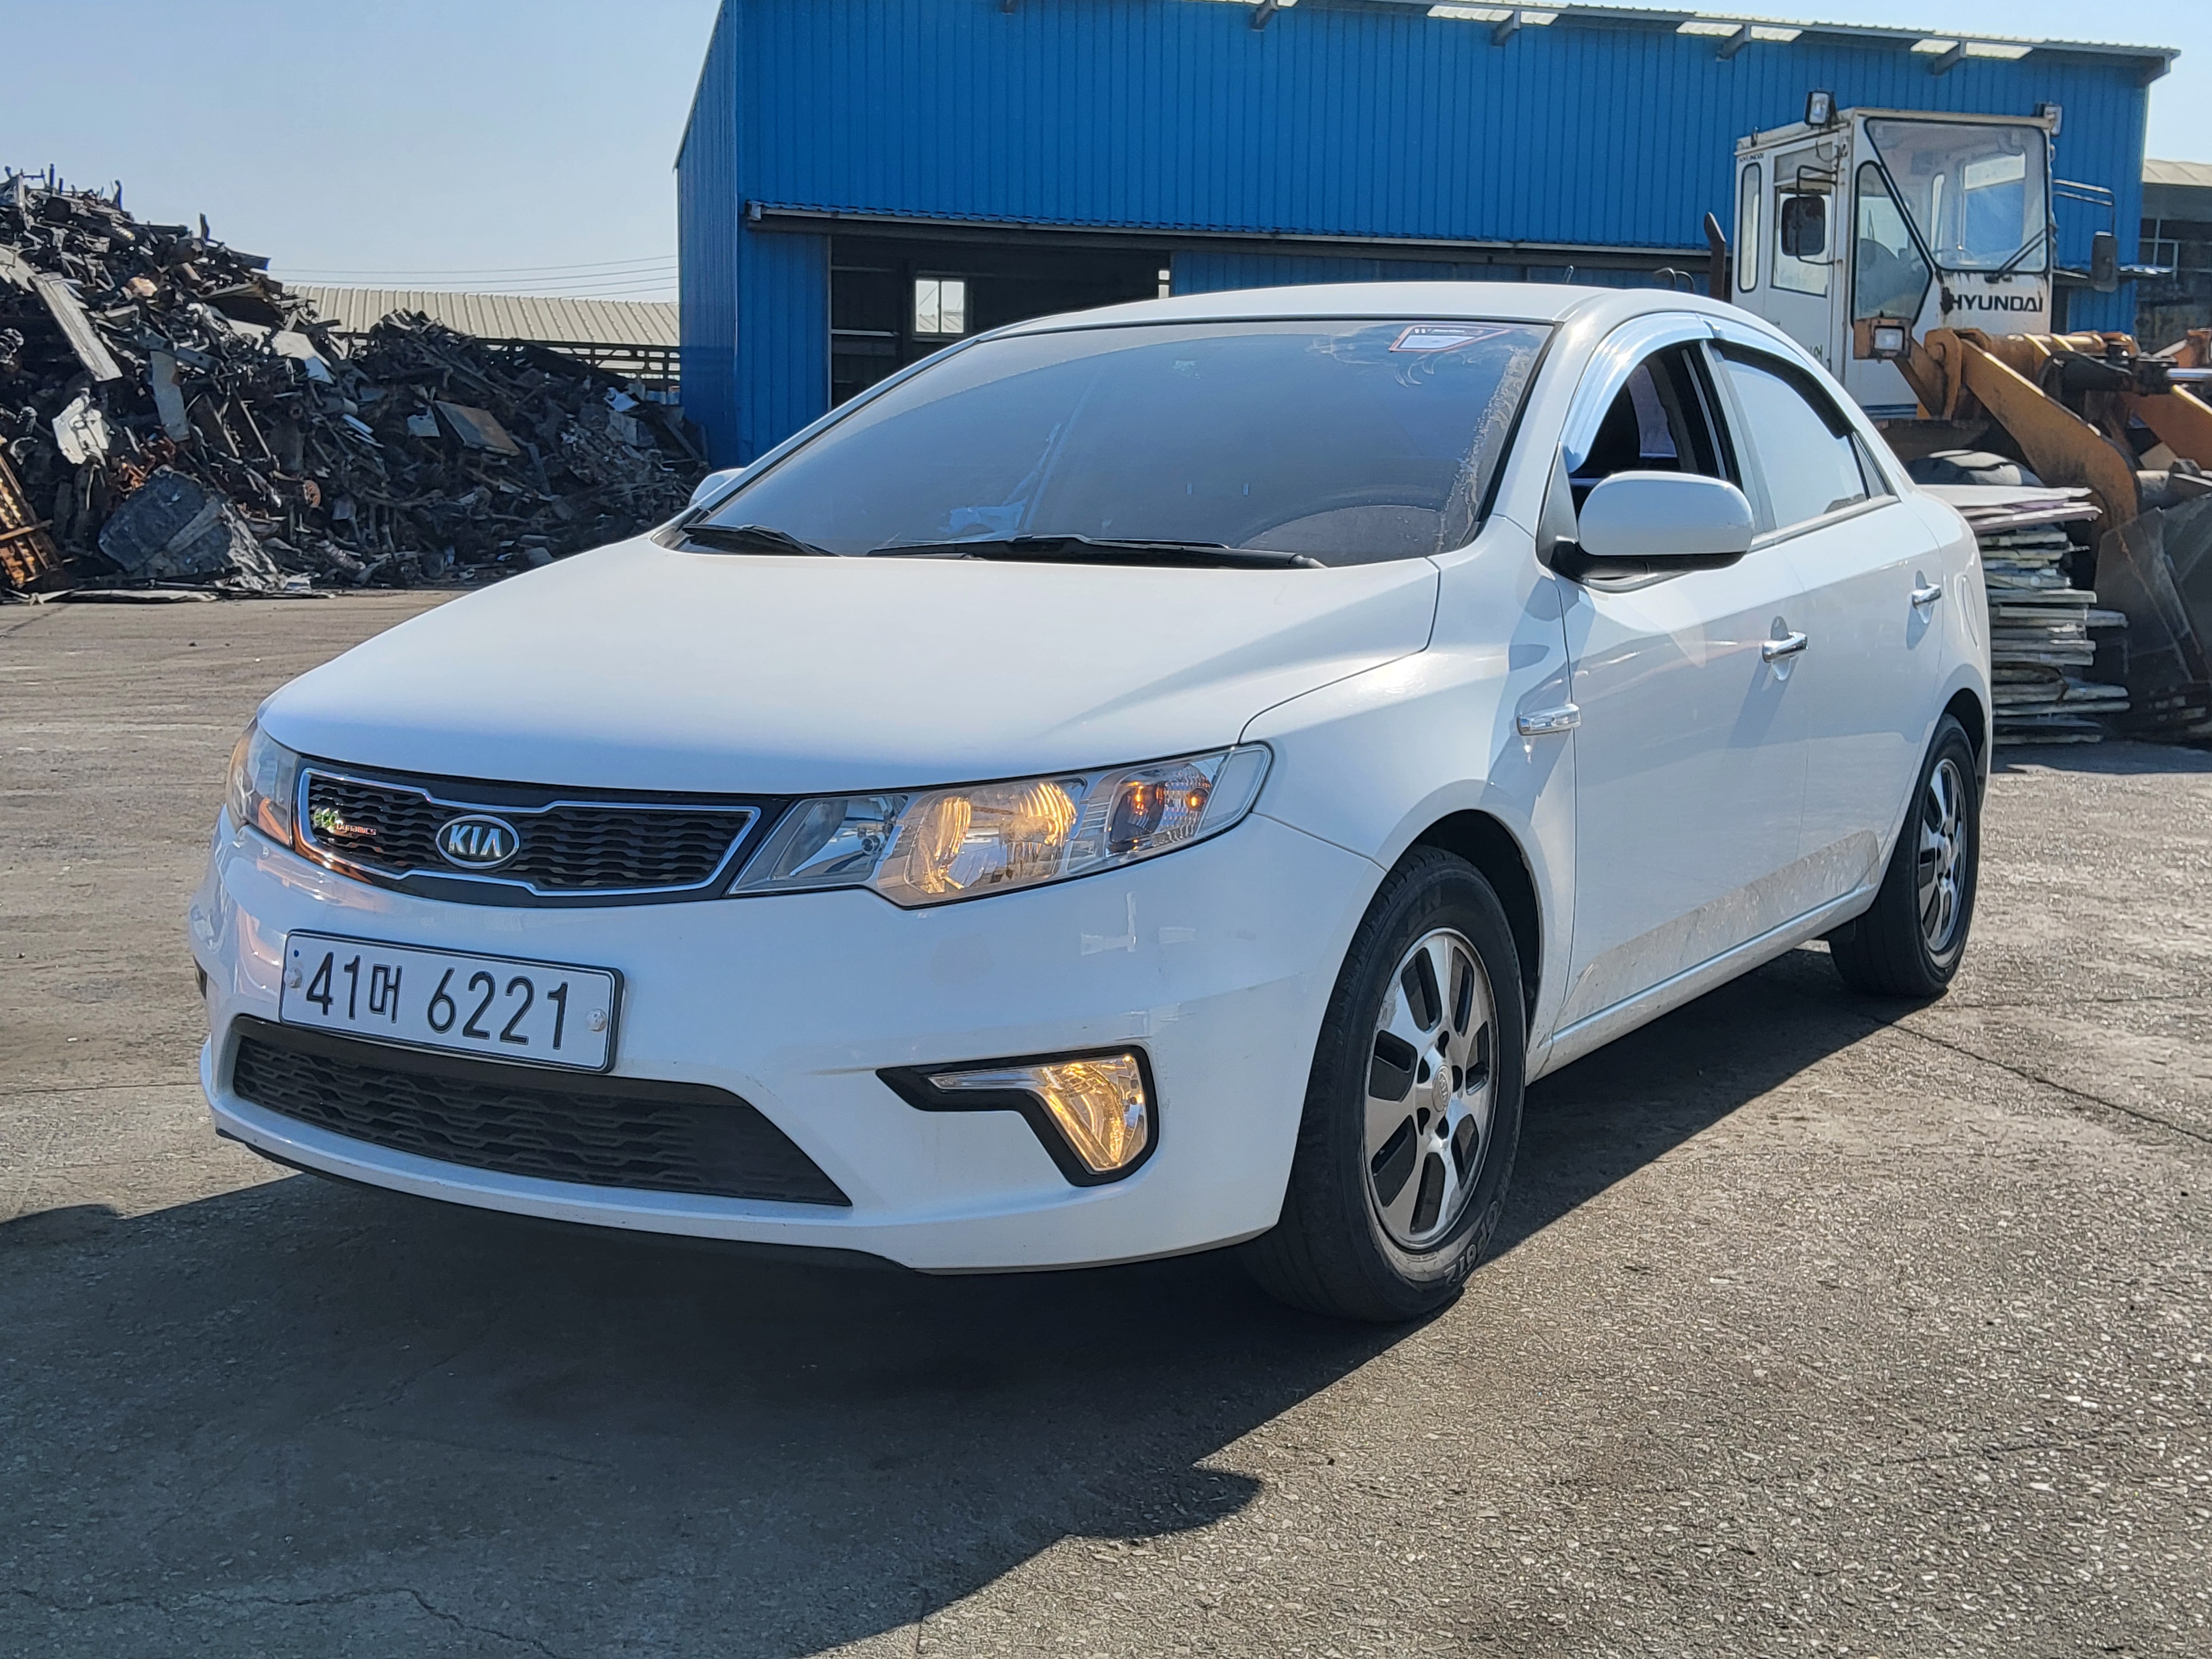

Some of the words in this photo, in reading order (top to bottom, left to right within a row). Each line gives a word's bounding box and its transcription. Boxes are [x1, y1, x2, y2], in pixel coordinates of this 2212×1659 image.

[1948, 294, 2043, 312] HYUNDAI
[448, 825, 503, 858] KIA
[306, 951, 402, 1024] 41머
[427, 967, 569, 1050] 6221
